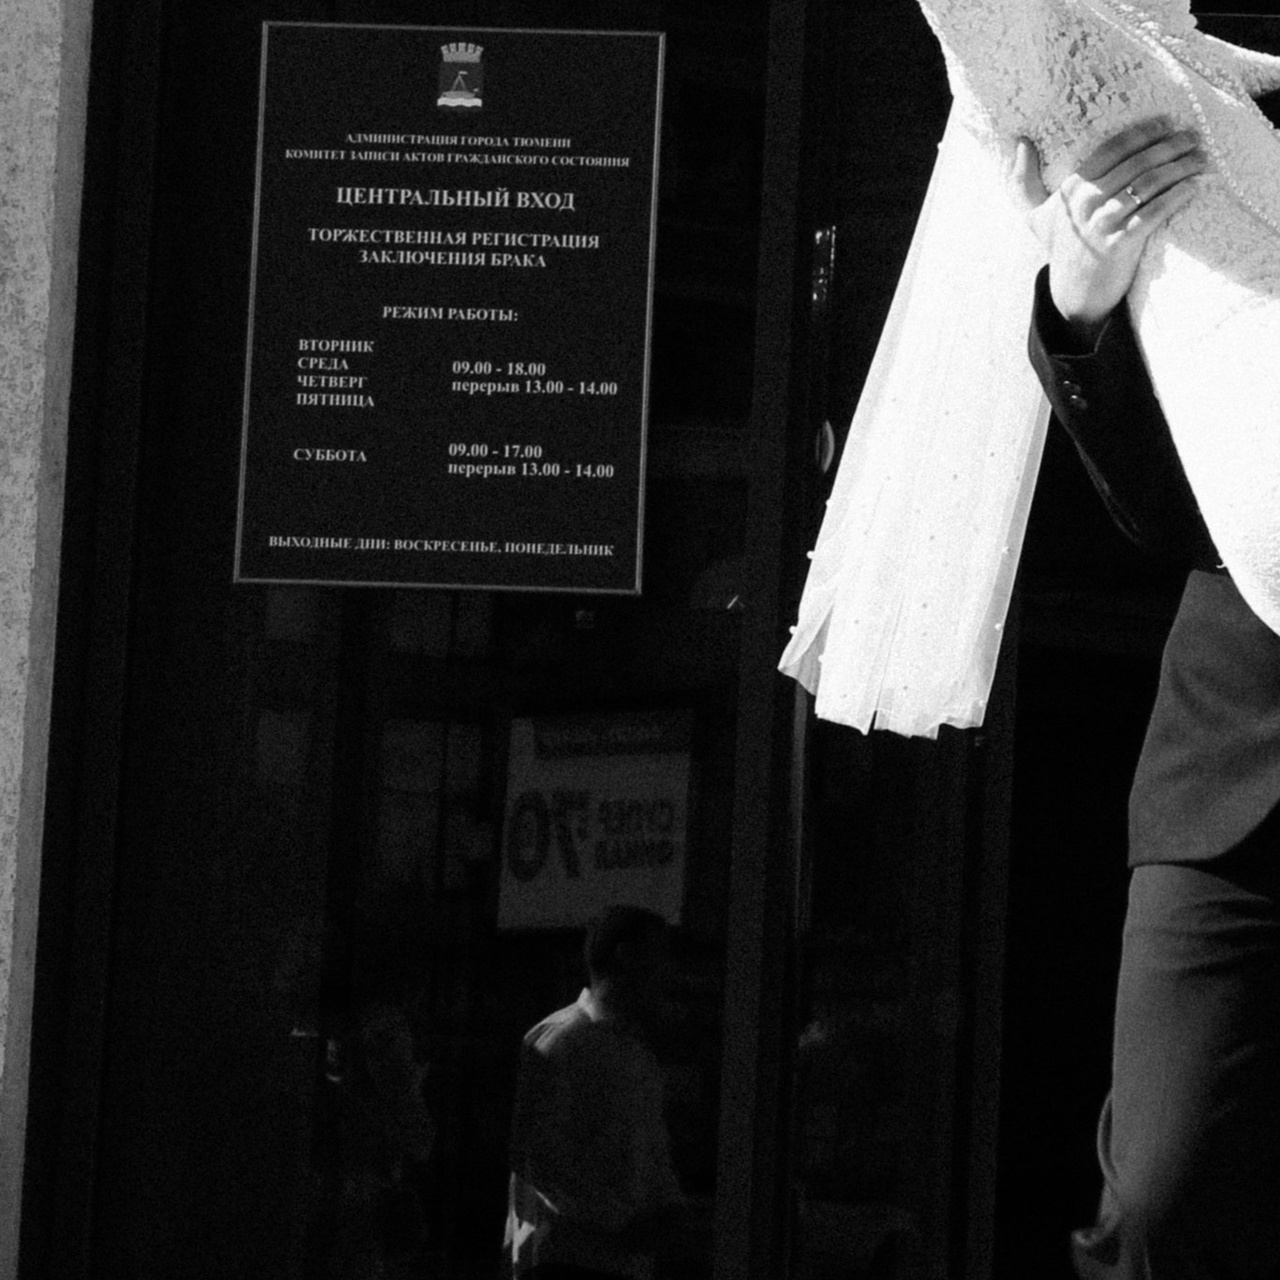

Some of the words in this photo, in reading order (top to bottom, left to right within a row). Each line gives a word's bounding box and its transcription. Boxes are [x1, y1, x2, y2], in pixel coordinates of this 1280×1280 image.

[459, 135, 510, 147] ГОРОДА
[512, 136, 571, 148] ТЮМЕНИ
[284, 148, 346, 160] КОМИТЕТ
[349, 150, 400, 162] ЗАПИСИ
[403, 152, 445, 163] АКТОВ
[445, 152, 550, 165] ГРАЖДАНСКОГО
[549, 155, 630, 167] СОСТОЯНИЯ
[335, 186, 510, 208] ЦЕНТРАЛЬНЫЙ
[515, 191, 576, 212] ВХОД
[307, 227, 467, 246] ТОРЖЕСТВЕННАЯ
[470, 231, 600, 249] РЕГИСТРАЦИЯ
[360, 249, 486, 267] ЗАКЛЮЧЕНИЯ
[489, 252, 547, 268] БРАКА
[381, 305, 444, 320] РЕЖИМ
[446, 307, 519, 322] РАБОТЫ:
[297, 338, 375, 353] ВТОРНИК
[296, 356, 349, 371] СРЕДА
[450, 360, 493, 375] 09.00
[506, 362, 547, 376] 18.00
[295, 374, 367, 389] ЧЕТВЕРГ
[450, 381, 520, 396] перерыв
[524, 379, 565, 394] 13.00
[578, 381, 619, 396] 14.00
[295, 392, 375, 408] ПЯТНИЦА
[291, 448, 367, 463] СУББОТА
[447, 443, 489, 458] 09.00
[503, 444, 543, 459] 17.00
[446, 463, 517, 479] перерыв
[520, 461, 561, 477] 13.00
[575, 463, 615, 478] 14.00
[267, 535, 351, 549] ВЫХОДНЫЕ
[353, 538, 390, 550] ДНИ:
[392, 539, 502, 554] ВОСКРЕСЕНЬЕ,
[503, 541, 614, 557] ПОНЕДЕЛЬНИК
